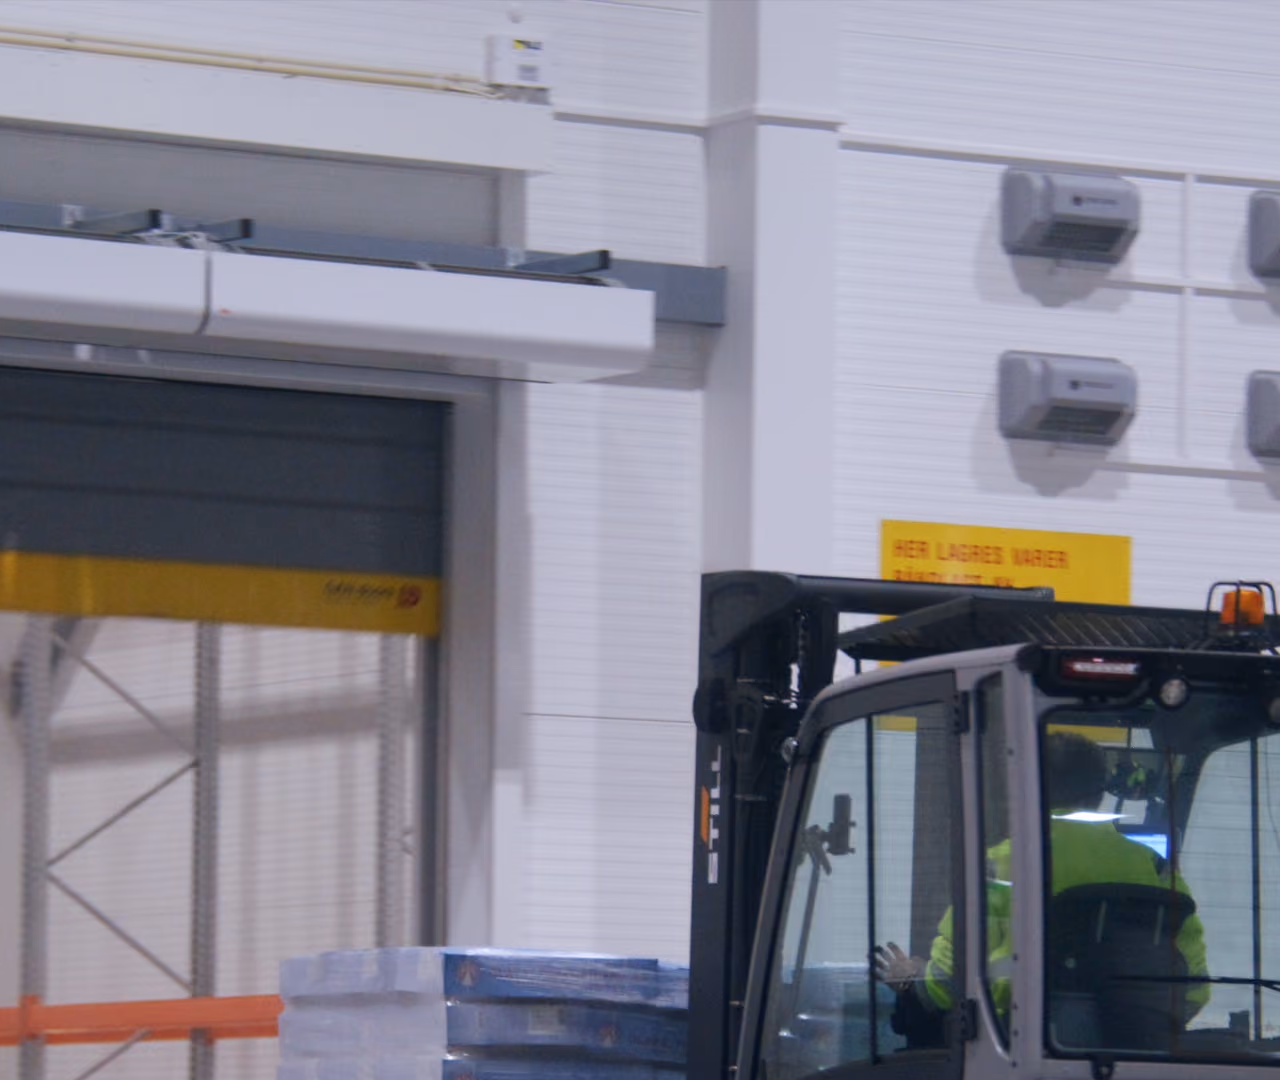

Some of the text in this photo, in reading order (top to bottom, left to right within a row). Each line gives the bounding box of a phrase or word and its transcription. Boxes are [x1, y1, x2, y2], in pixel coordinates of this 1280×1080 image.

[894, 539, 1069, 569] HER LAGRES VARER
[708, 745, 721, 884] STILL
